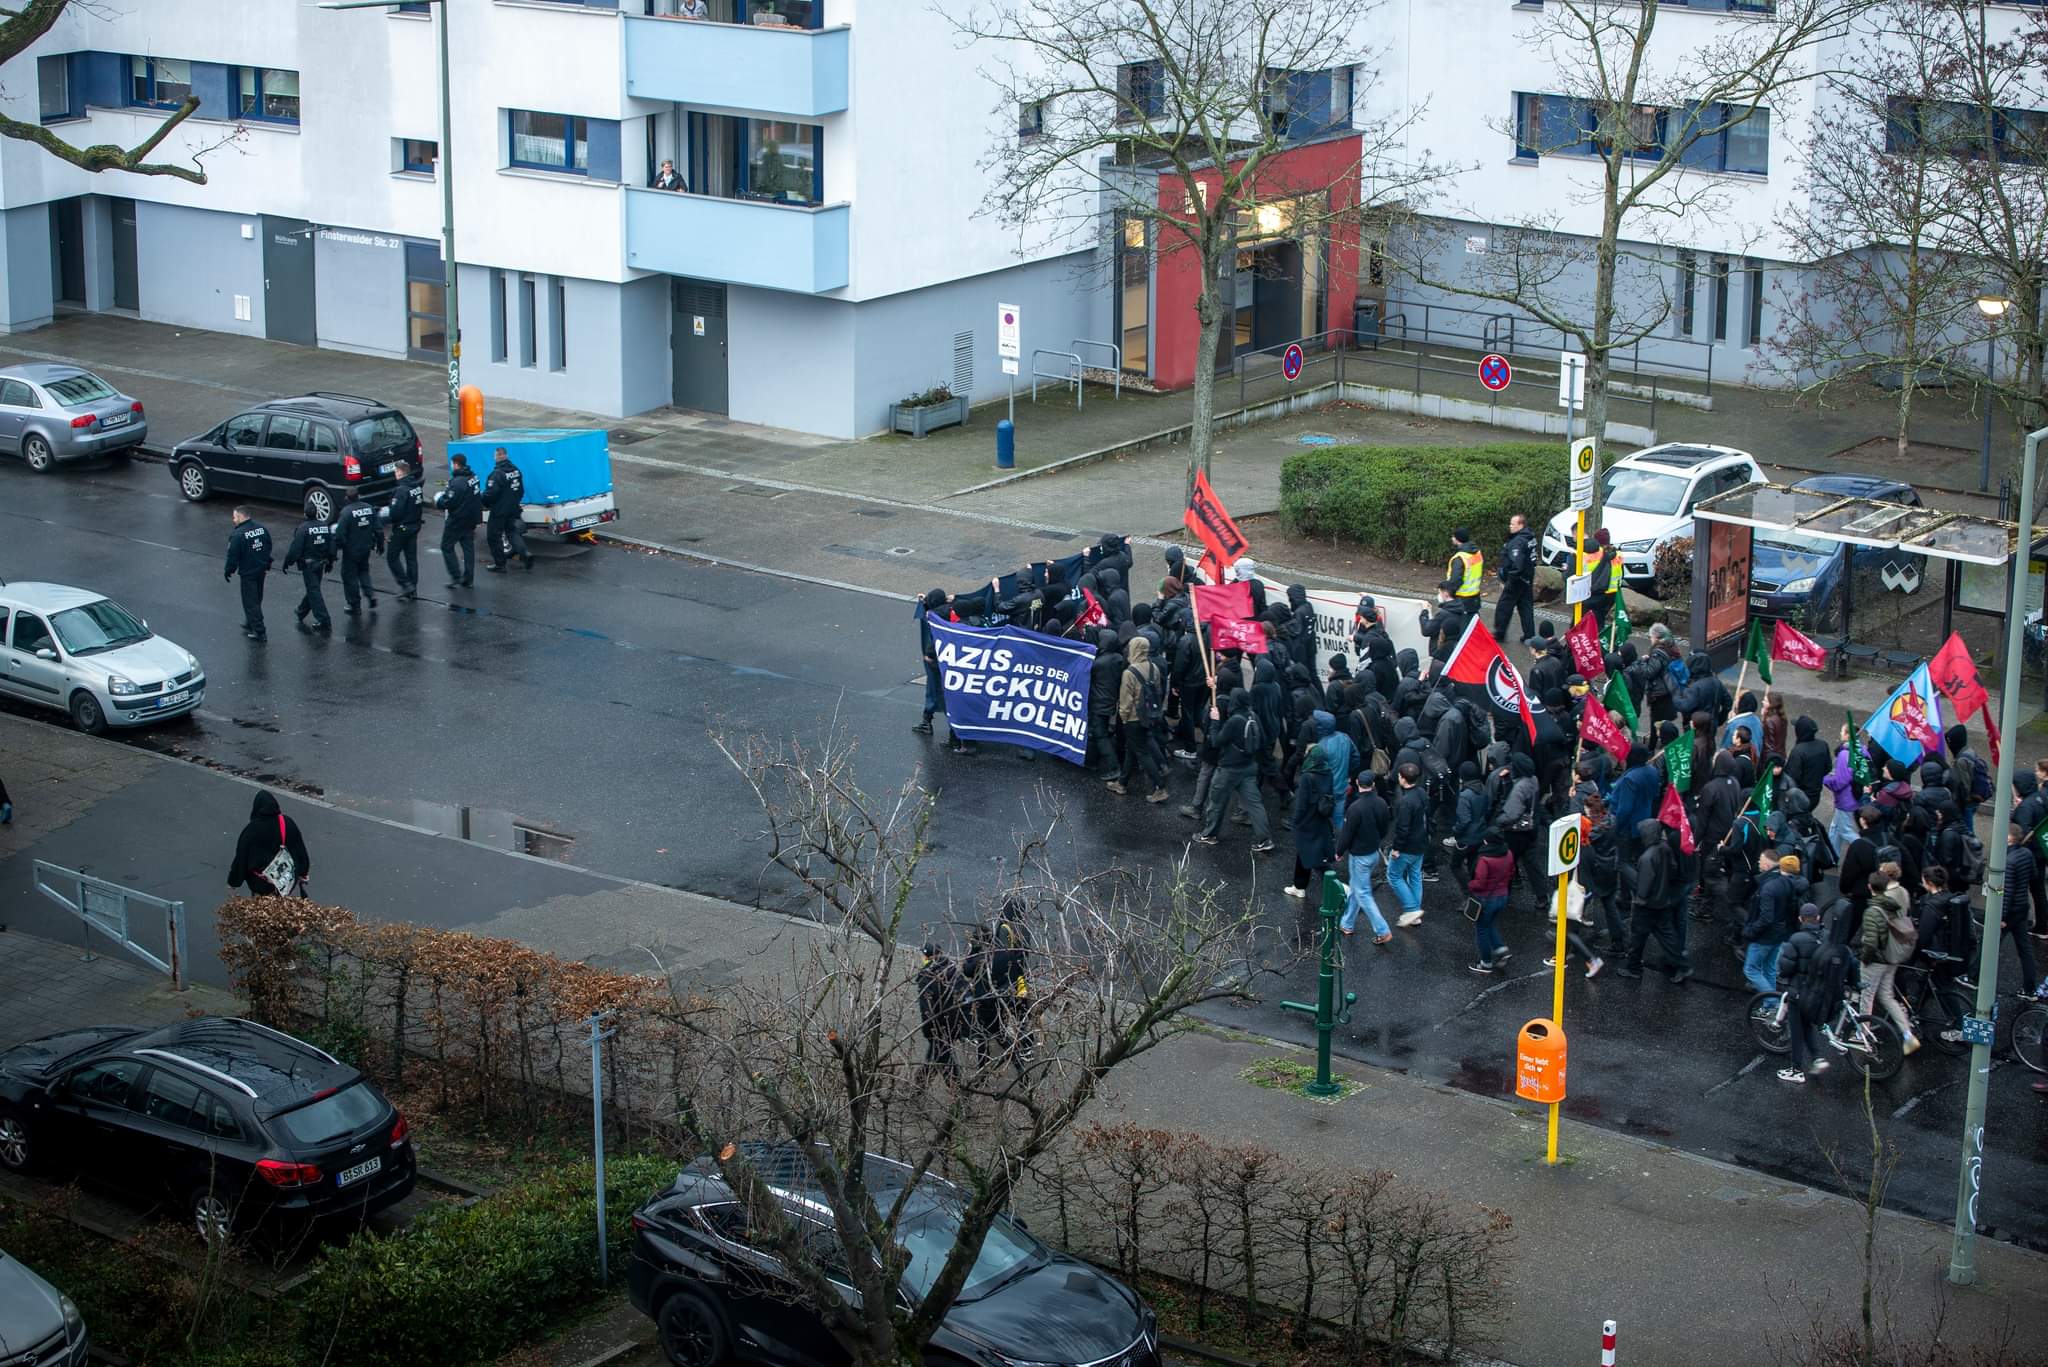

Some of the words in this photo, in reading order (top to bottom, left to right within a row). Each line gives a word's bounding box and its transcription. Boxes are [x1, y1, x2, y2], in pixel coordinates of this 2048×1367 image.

[320, 230, 373, 246] Finsterwalder
[374, 239, 388, 248] Str.
[389, 239, 399, 248] 27
[1618, 255, 1629, 265] 21
[352, 507, 374, 518] POLIZEI
[244, 527, 265, 540] POLIZEI
[308, 526, 329, 536] POLIZEI
[1013, 663, 1044, 676] AUS
[1047, 667, 1070, 683] DER
[944, 669, 1083, 712] DECKUNG
[987, 700, 1088, 741] HOLEN!
[364, 1159, 378, 1173] 613
